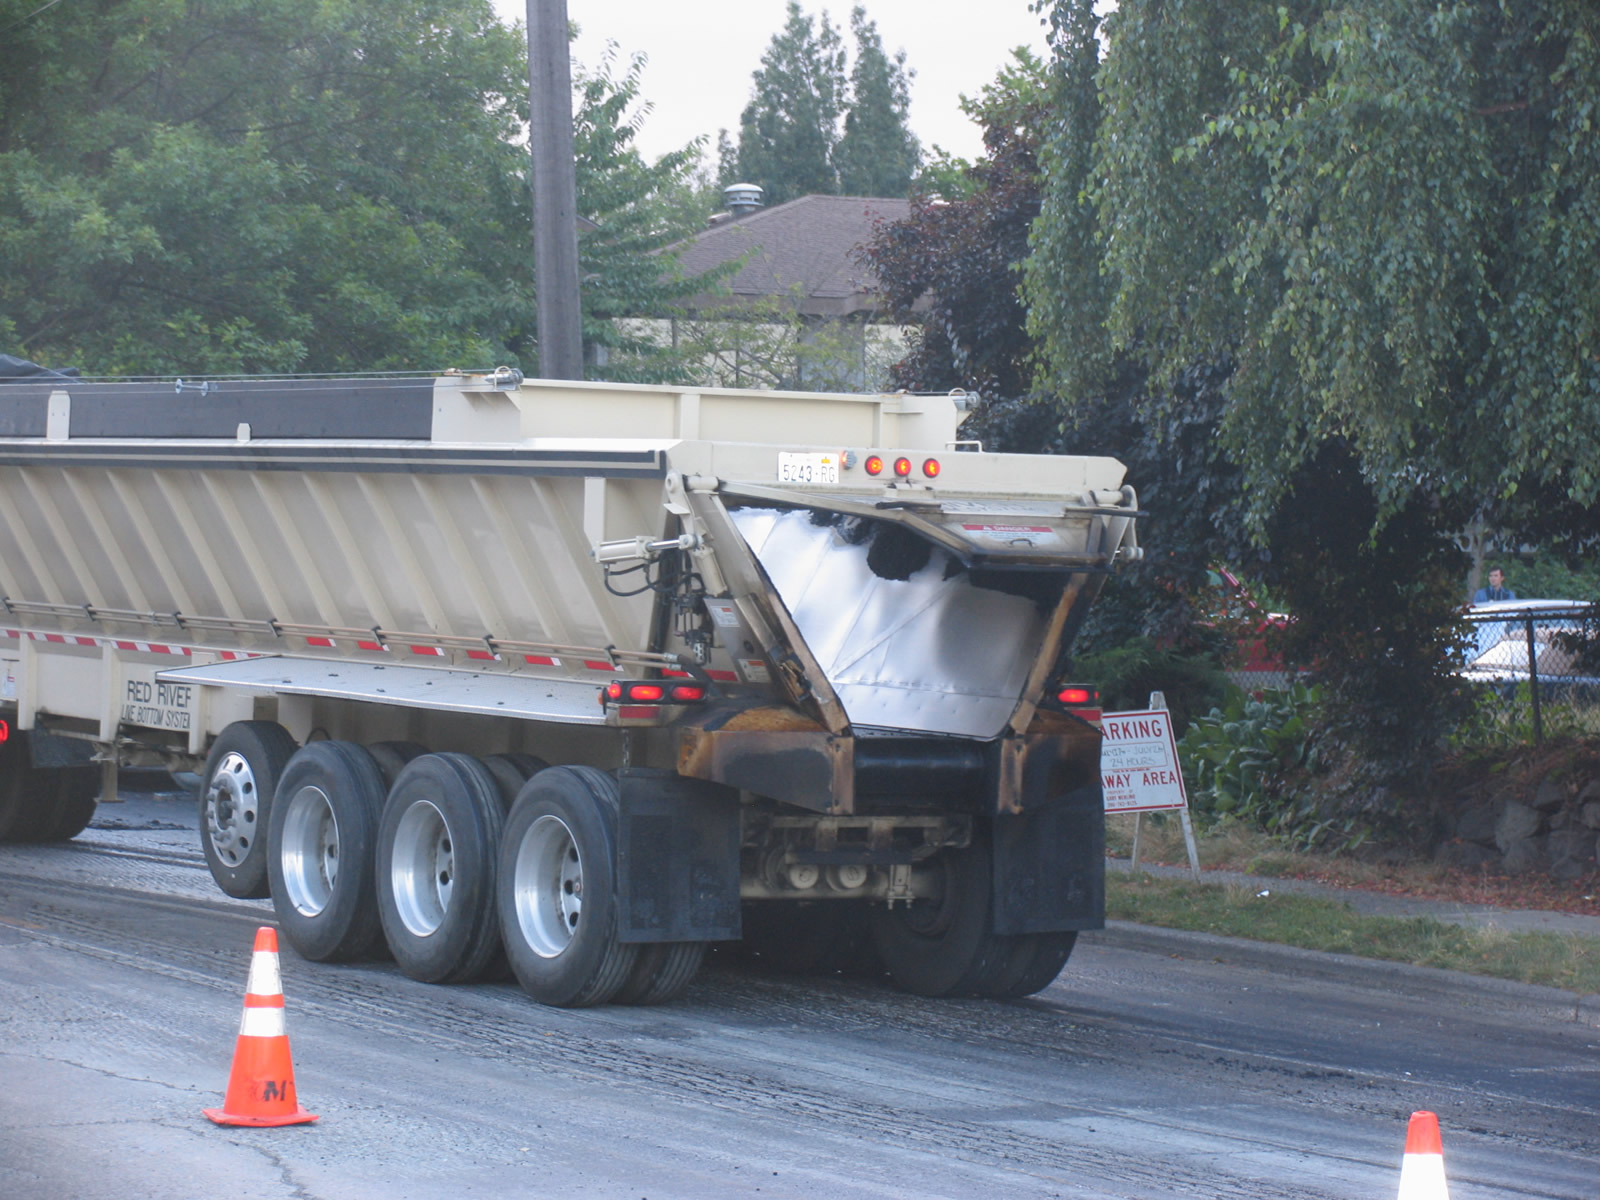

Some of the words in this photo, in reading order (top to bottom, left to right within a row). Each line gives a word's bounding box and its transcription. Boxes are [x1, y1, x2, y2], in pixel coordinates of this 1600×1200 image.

[127, 680, 152, 703] RED
[137, 706, 164, 725] BOTTOM
[1142, 771, 1178, 786] AREA
